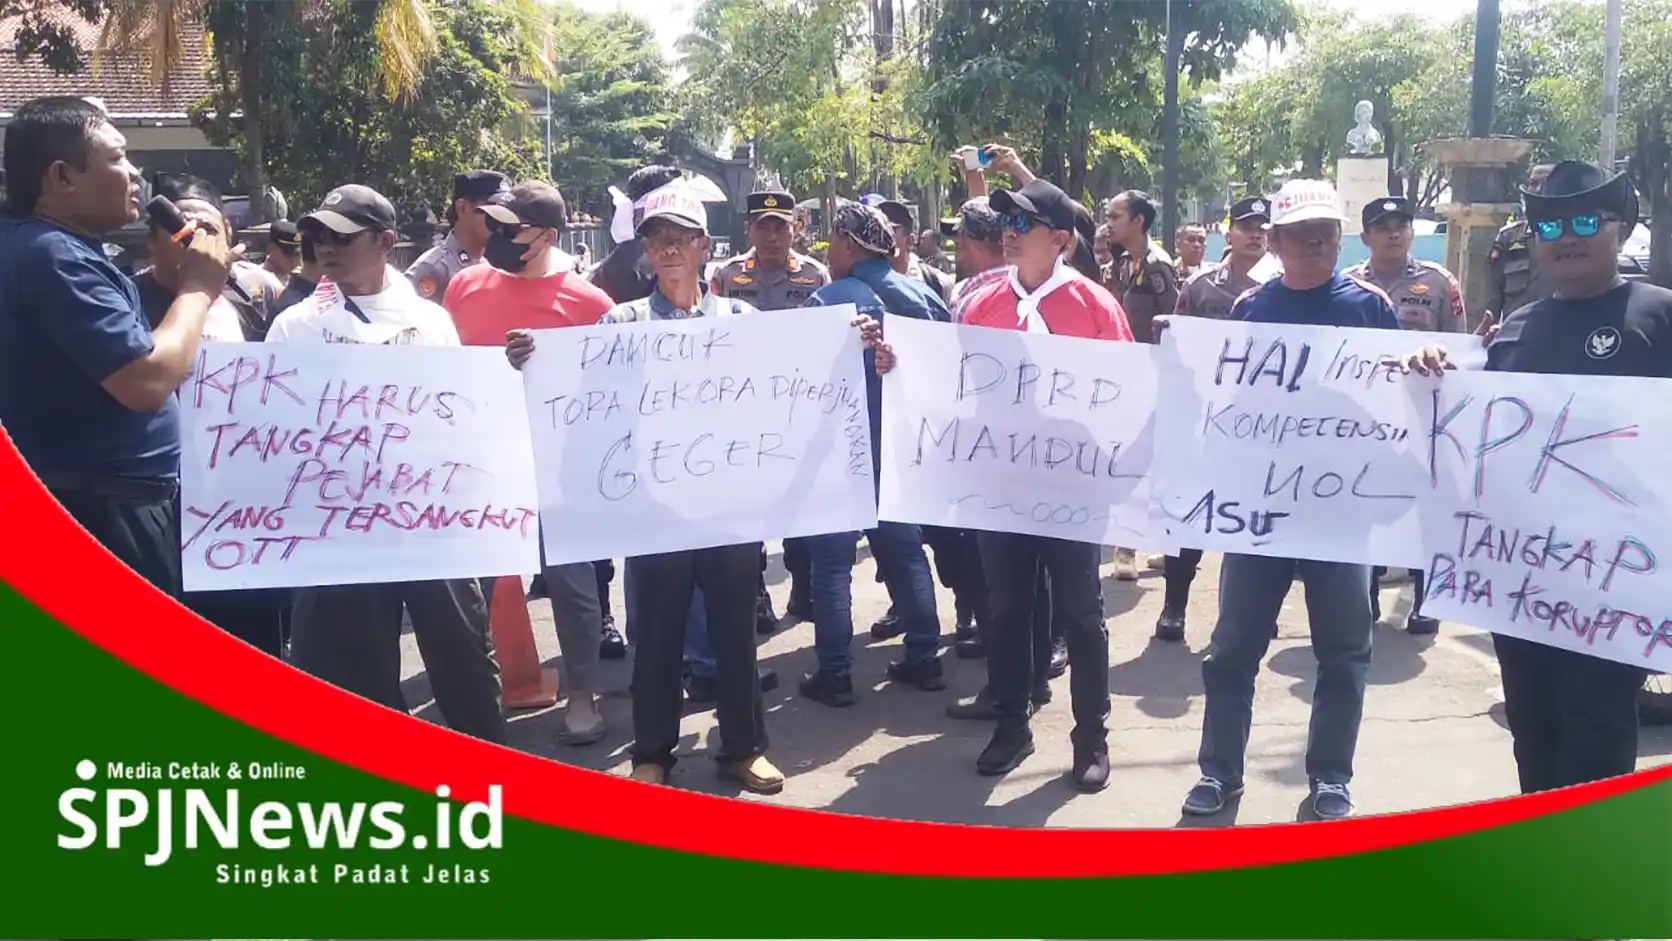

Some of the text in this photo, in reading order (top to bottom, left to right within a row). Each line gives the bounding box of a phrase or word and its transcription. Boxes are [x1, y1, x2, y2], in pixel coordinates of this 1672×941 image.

[579, 329, 732, 371] DANCUK
[1214, 336, 1312, 392] HAI
[194, 348, 475, 426] KPK HARUS
[956, 352, 1122, 410] DPRD
[545, 391, 621, 430] TORA
[206, 420, 411, 469] TANGKAP
[598, 430, 797, 502] GEGER
[909, 416, 1149, 479] MANDUL
[1427, 388, 1640, 509] KPK
[283, 458, 495, 506] PEJABAT
[1263, 460, 1417, 502] NOL
[182, 499, 537, 551] YANG TERSANGKUT
[204, 535, 332, 571] OTT
[1453, 510, 1658, 592] TANGKAP
[1422, 552, 1493, 608] PARA
